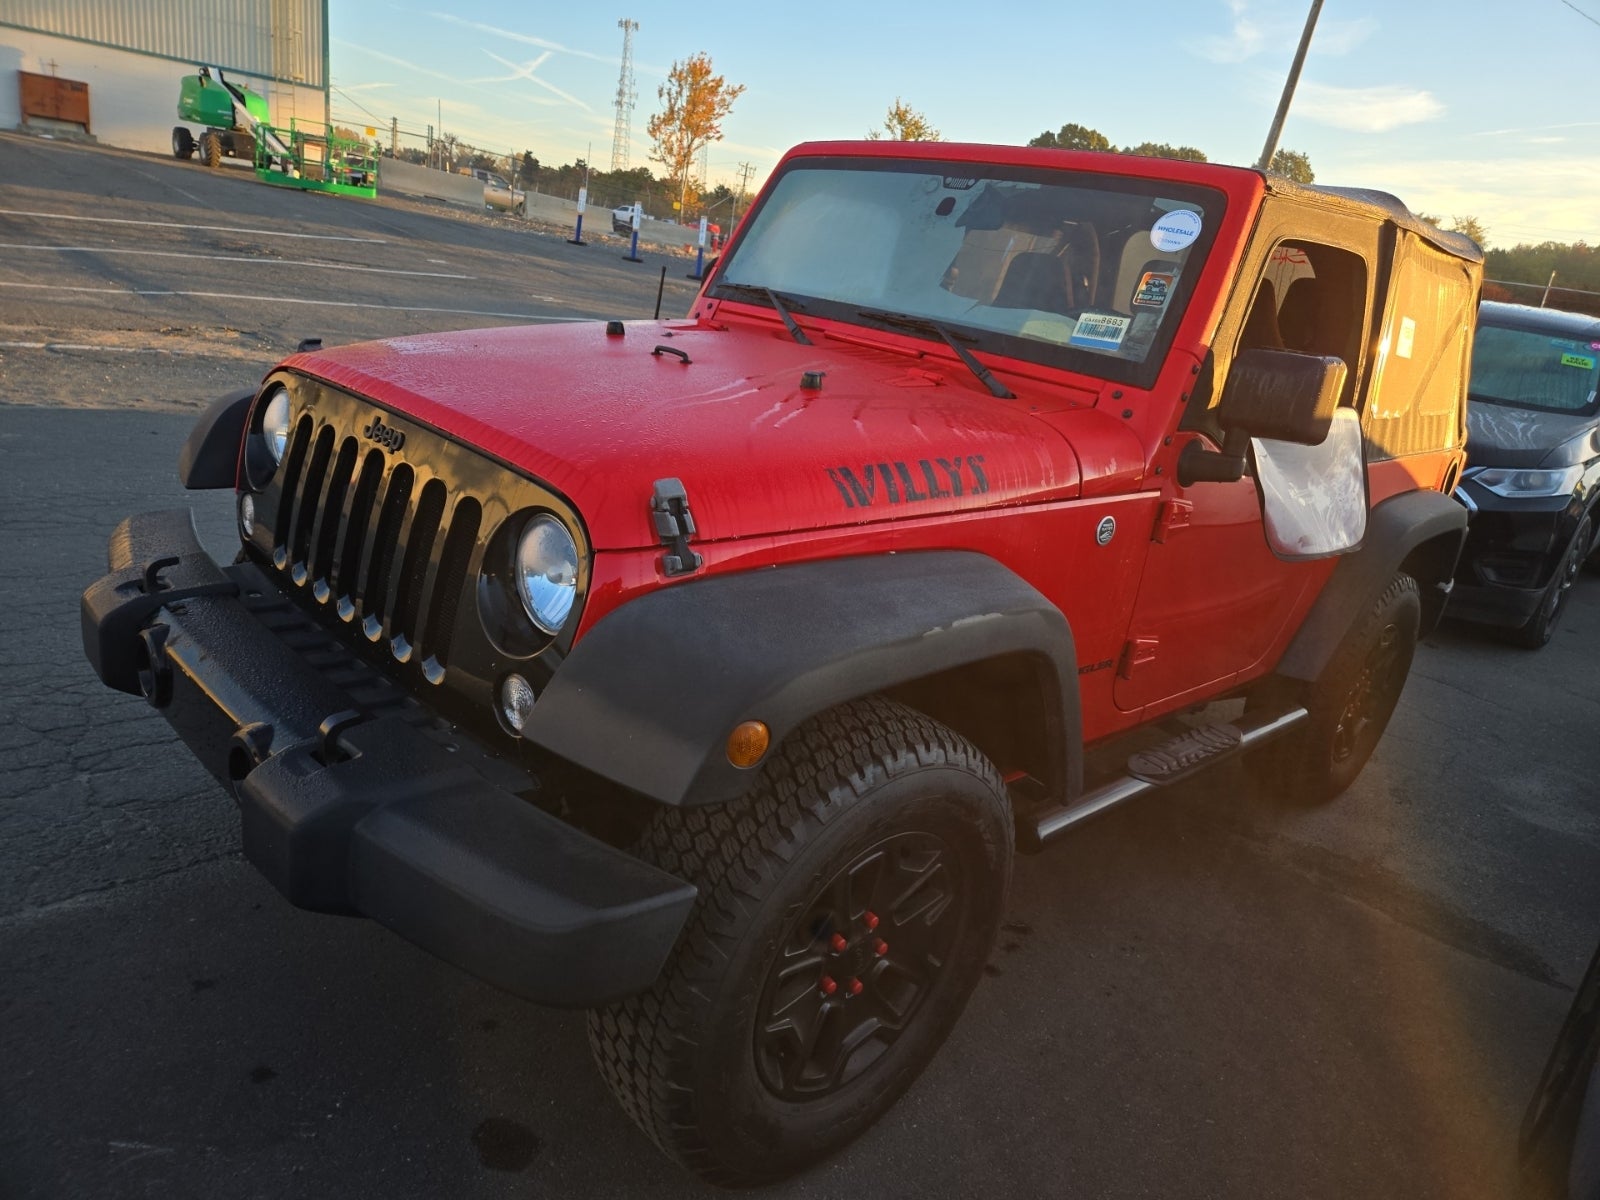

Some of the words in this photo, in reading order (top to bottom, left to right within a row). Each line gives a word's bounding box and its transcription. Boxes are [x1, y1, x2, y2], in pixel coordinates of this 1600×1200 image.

[1158, 226, 1194, 237] WHOLESALE
[363, 415, 406, 455] Jeep
[825, 454, 989, 508] WILLYS
[1079, 659, 1113, 675] GLER
